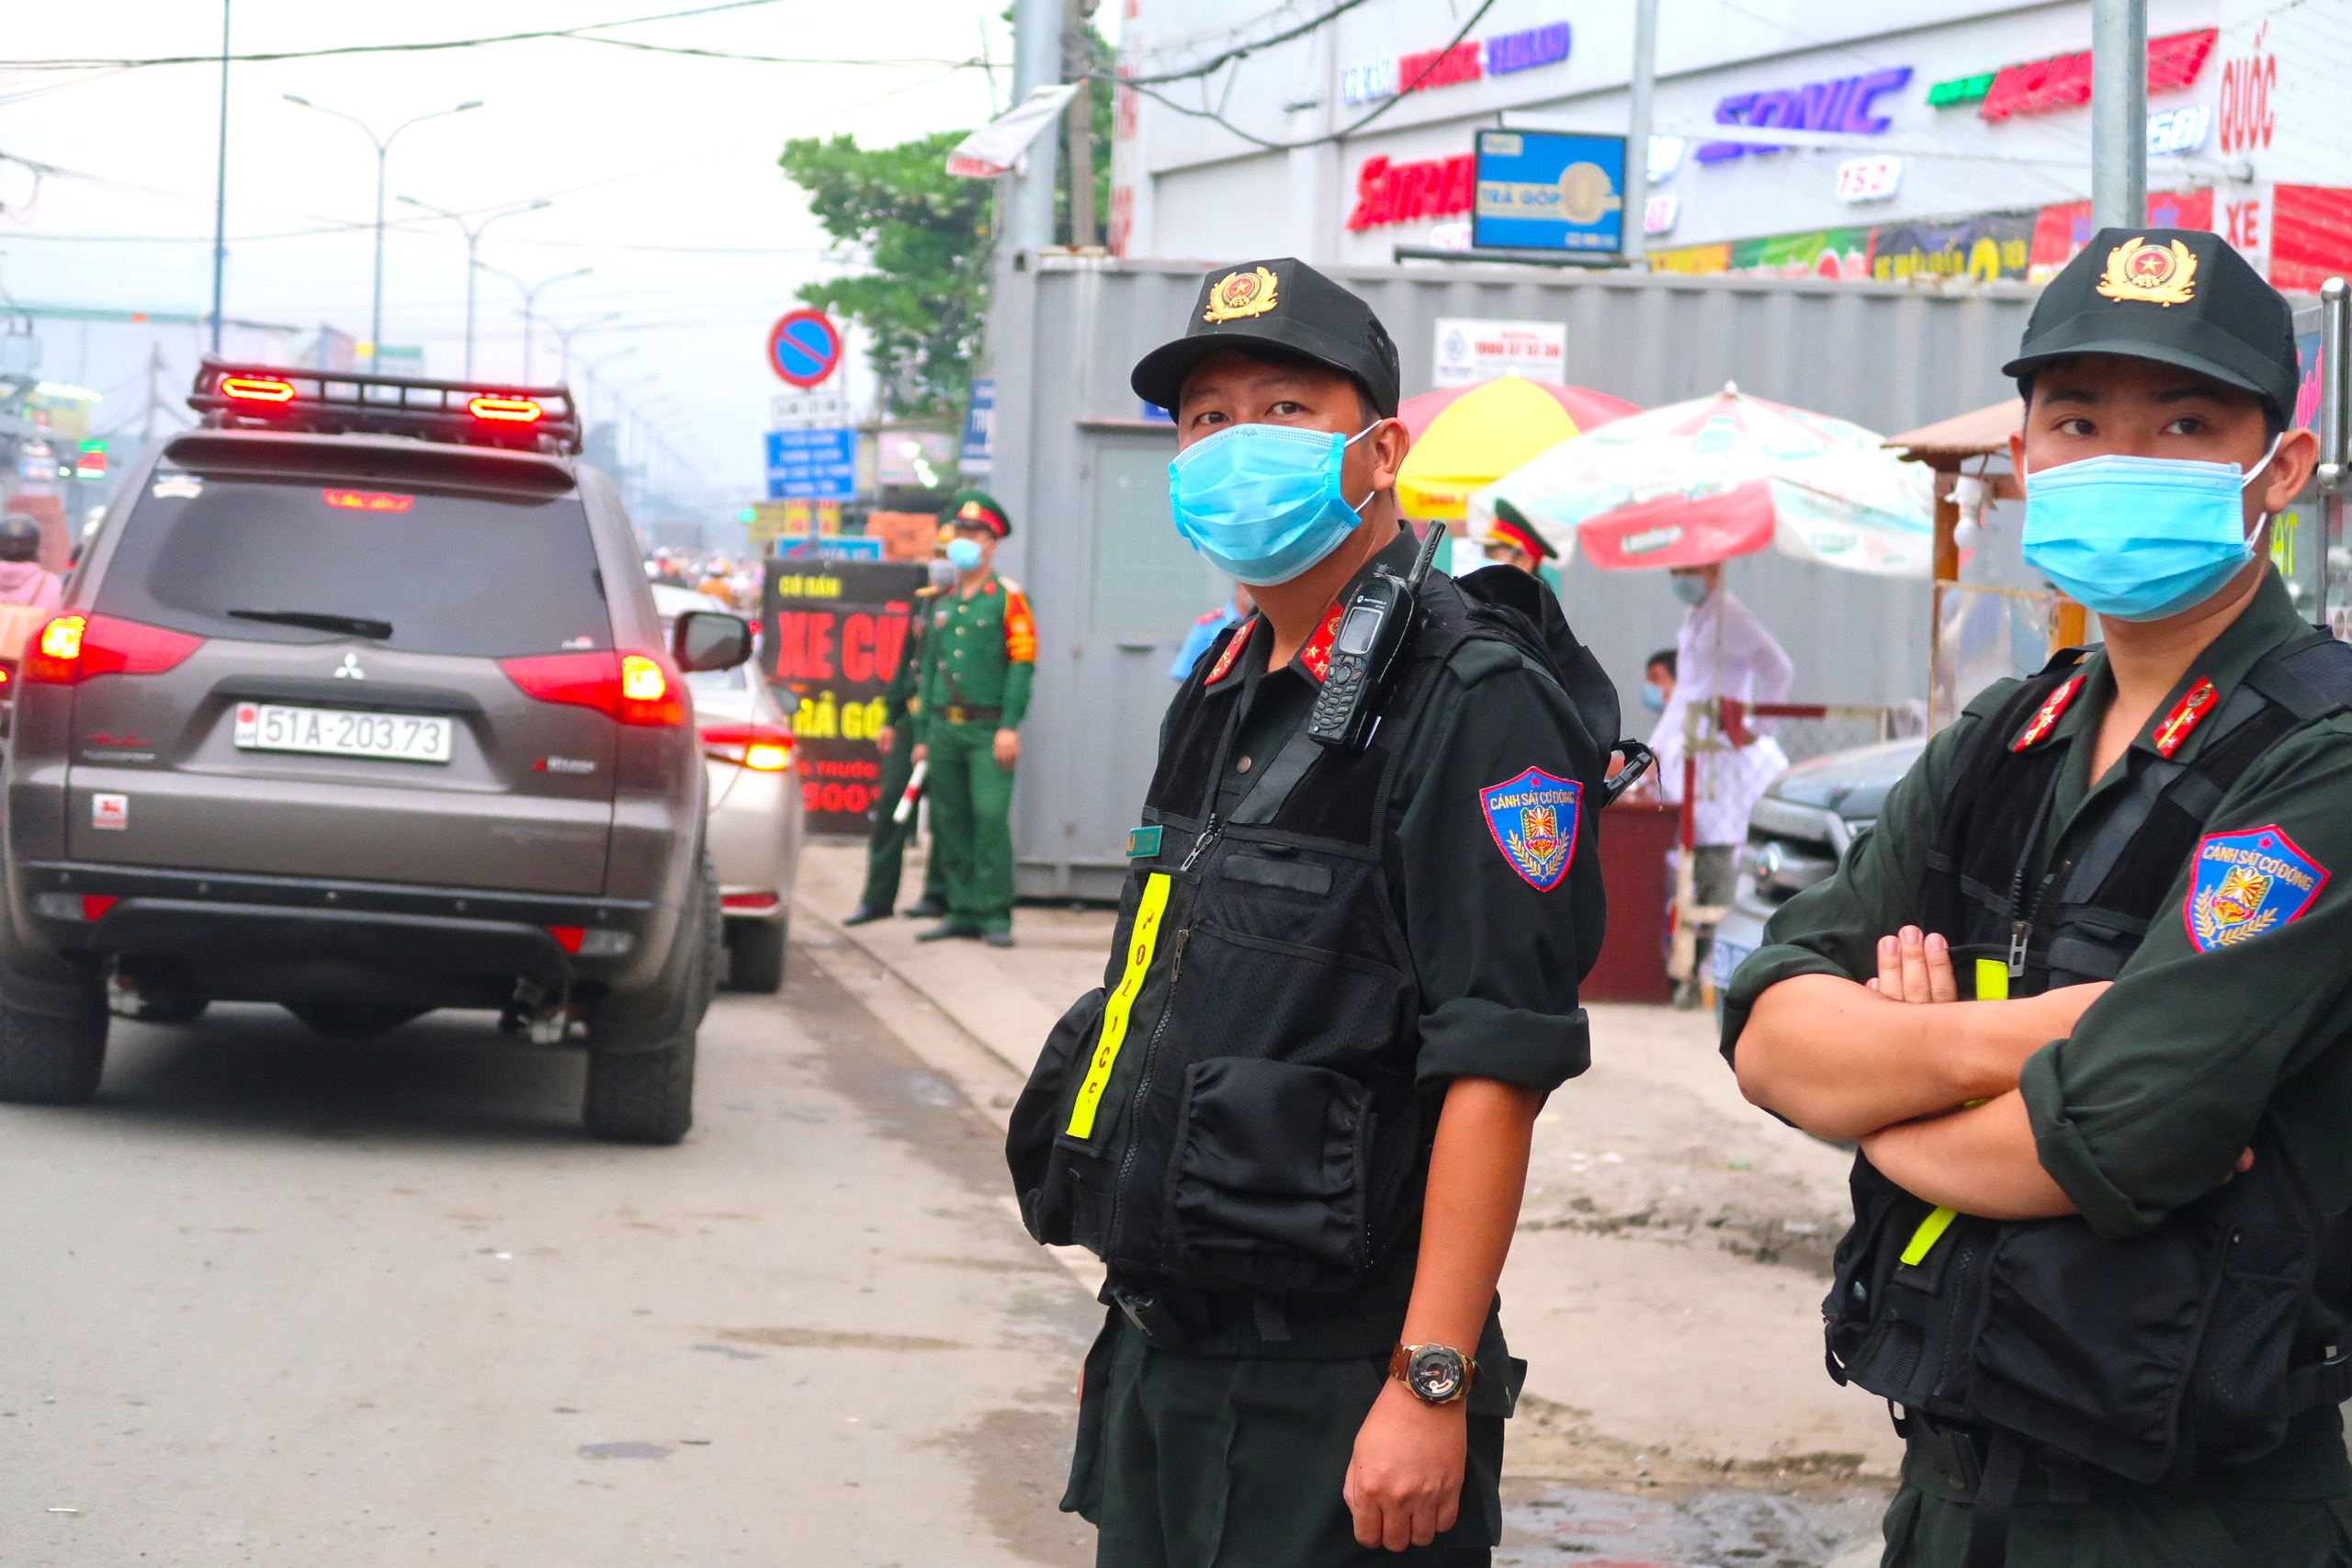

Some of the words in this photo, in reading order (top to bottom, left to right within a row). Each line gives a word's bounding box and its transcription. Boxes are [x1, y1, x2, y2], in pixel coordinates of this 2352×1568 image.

[2218, 18, 2276, 155] QUỐC
[1695, 64, 1912, 163] SONIC
[2224, 201, 2260, 249] XE
[776, 611, 834, 680] XE
[842, 600, 910, 683] CŨ
[266, 711, 441, 754] 51A-203.73
[1490, 794, 1521, 810] CẢNH
[1521, 790, 1539, 807] SÁT
[1539, 790, 1554, 805] CƠ
[1552, 788, 1576, 806] ĐỘNG
[2202, 842, 2238, 863] CẢNH
[2237, 849, 2263, 866] SÁT
[2258, 856, 2283, 874] CƠ
[2277, 864, 2315, 892] ĐỘNG
